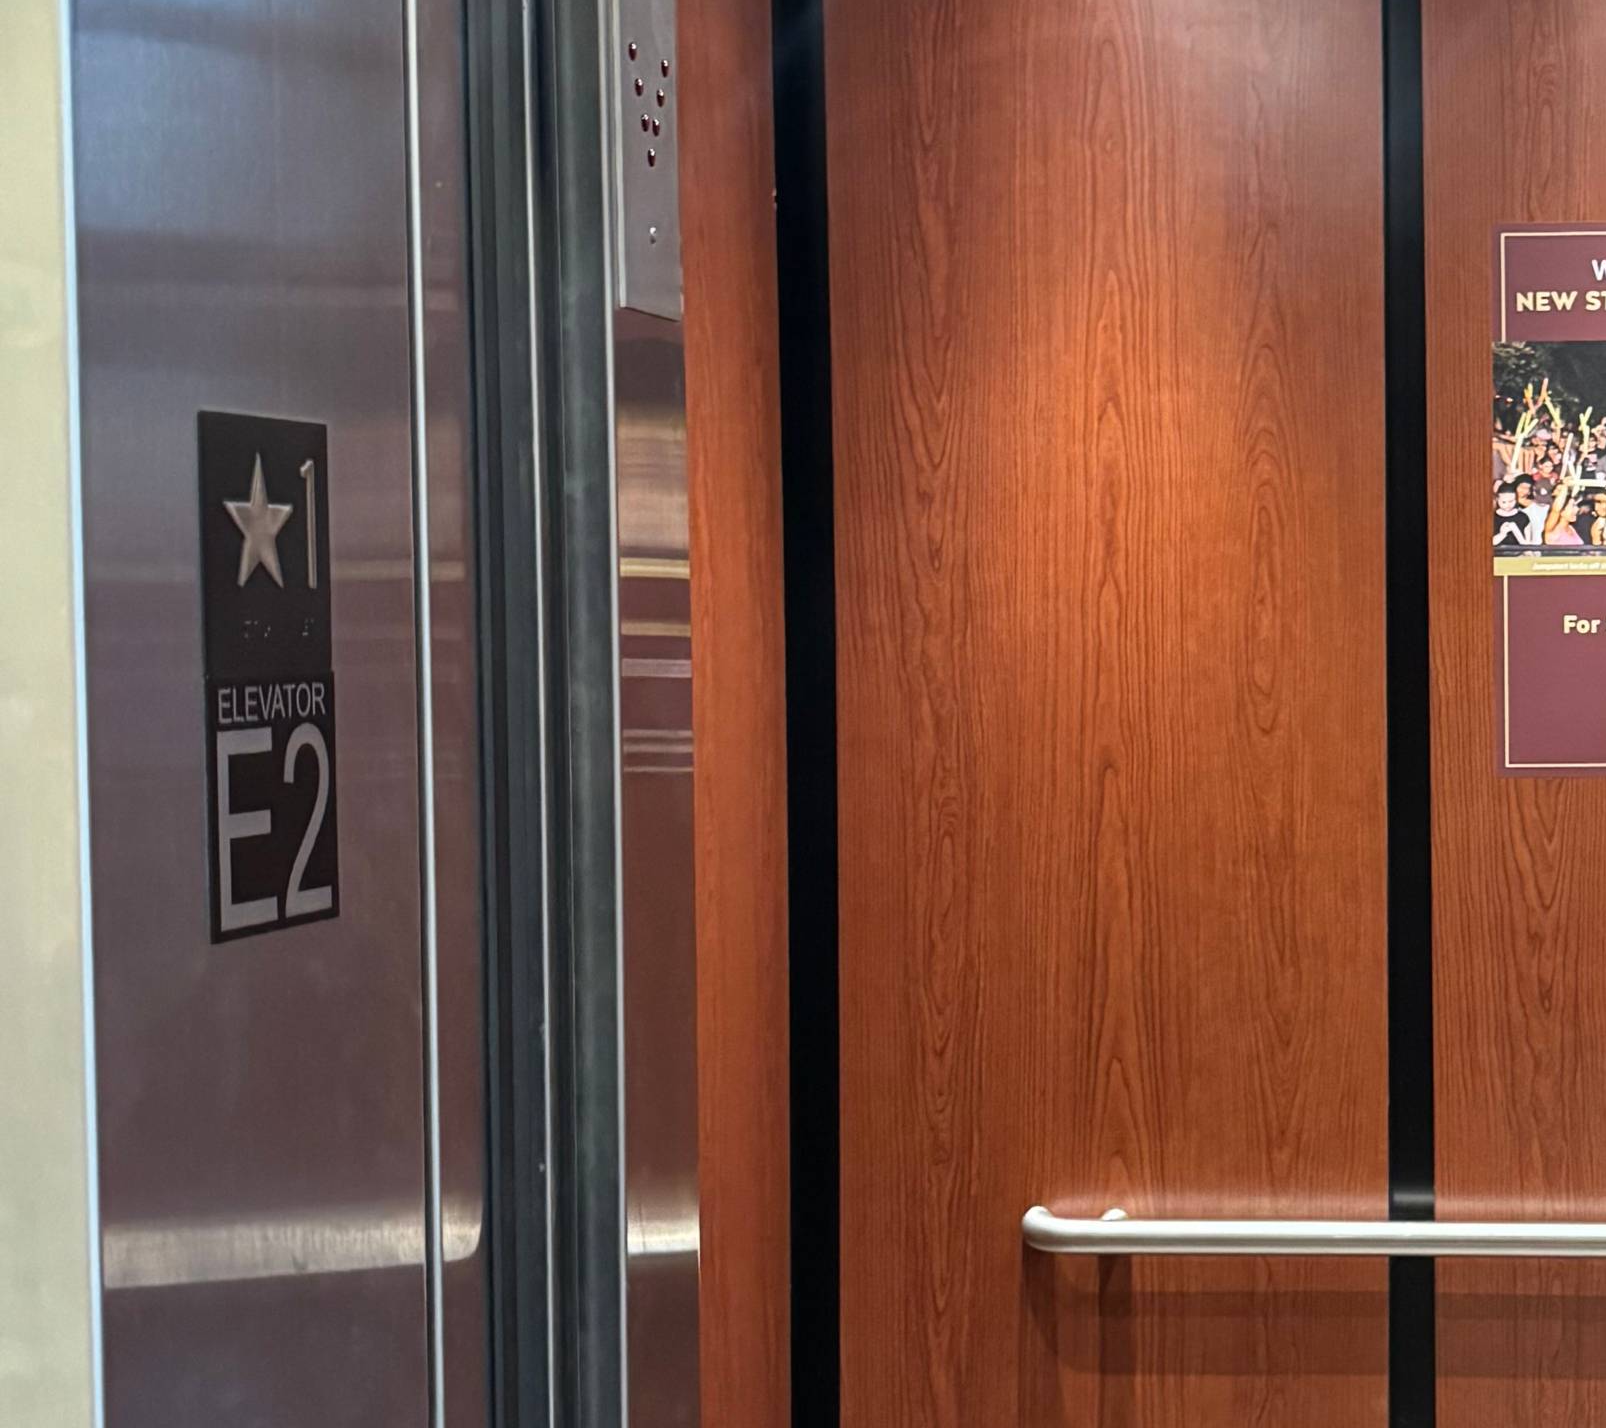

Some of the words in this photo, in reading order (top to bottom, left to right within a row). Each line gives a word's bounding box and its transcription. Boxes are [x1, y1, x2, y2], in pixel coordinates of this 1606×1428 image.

[1516, 290, 1578, 312] NEW
[300, 458, 317, 589] 1
[1563, 614, 1600, 634] For
[217, 682, 326, 724] ELEVATOR
[216, 722, 333, 932] E2
